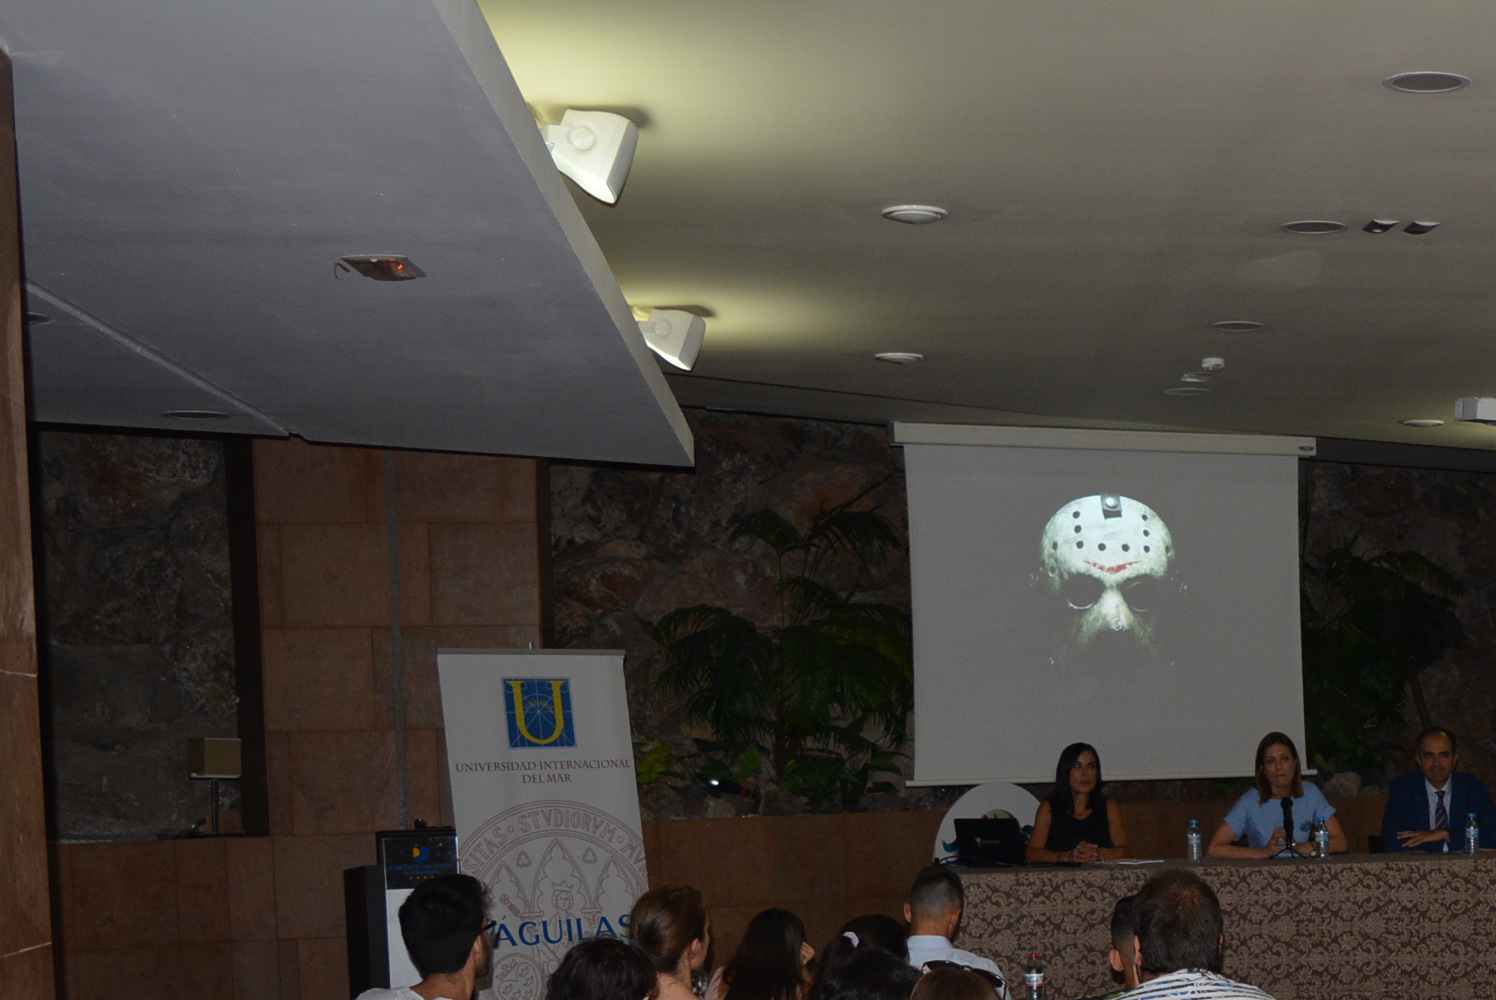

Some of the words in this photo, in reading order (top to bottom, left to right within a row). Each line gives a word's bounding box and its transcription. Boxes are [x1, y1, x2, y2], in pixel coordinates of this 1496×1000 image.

[455, 760, 536, 773] UNIVERSIDAD
[540, 758, 631, 771] INTERNACIONAL
[522, 774, 545, 784] DEL
[547, 773, 573, 784] MAR
